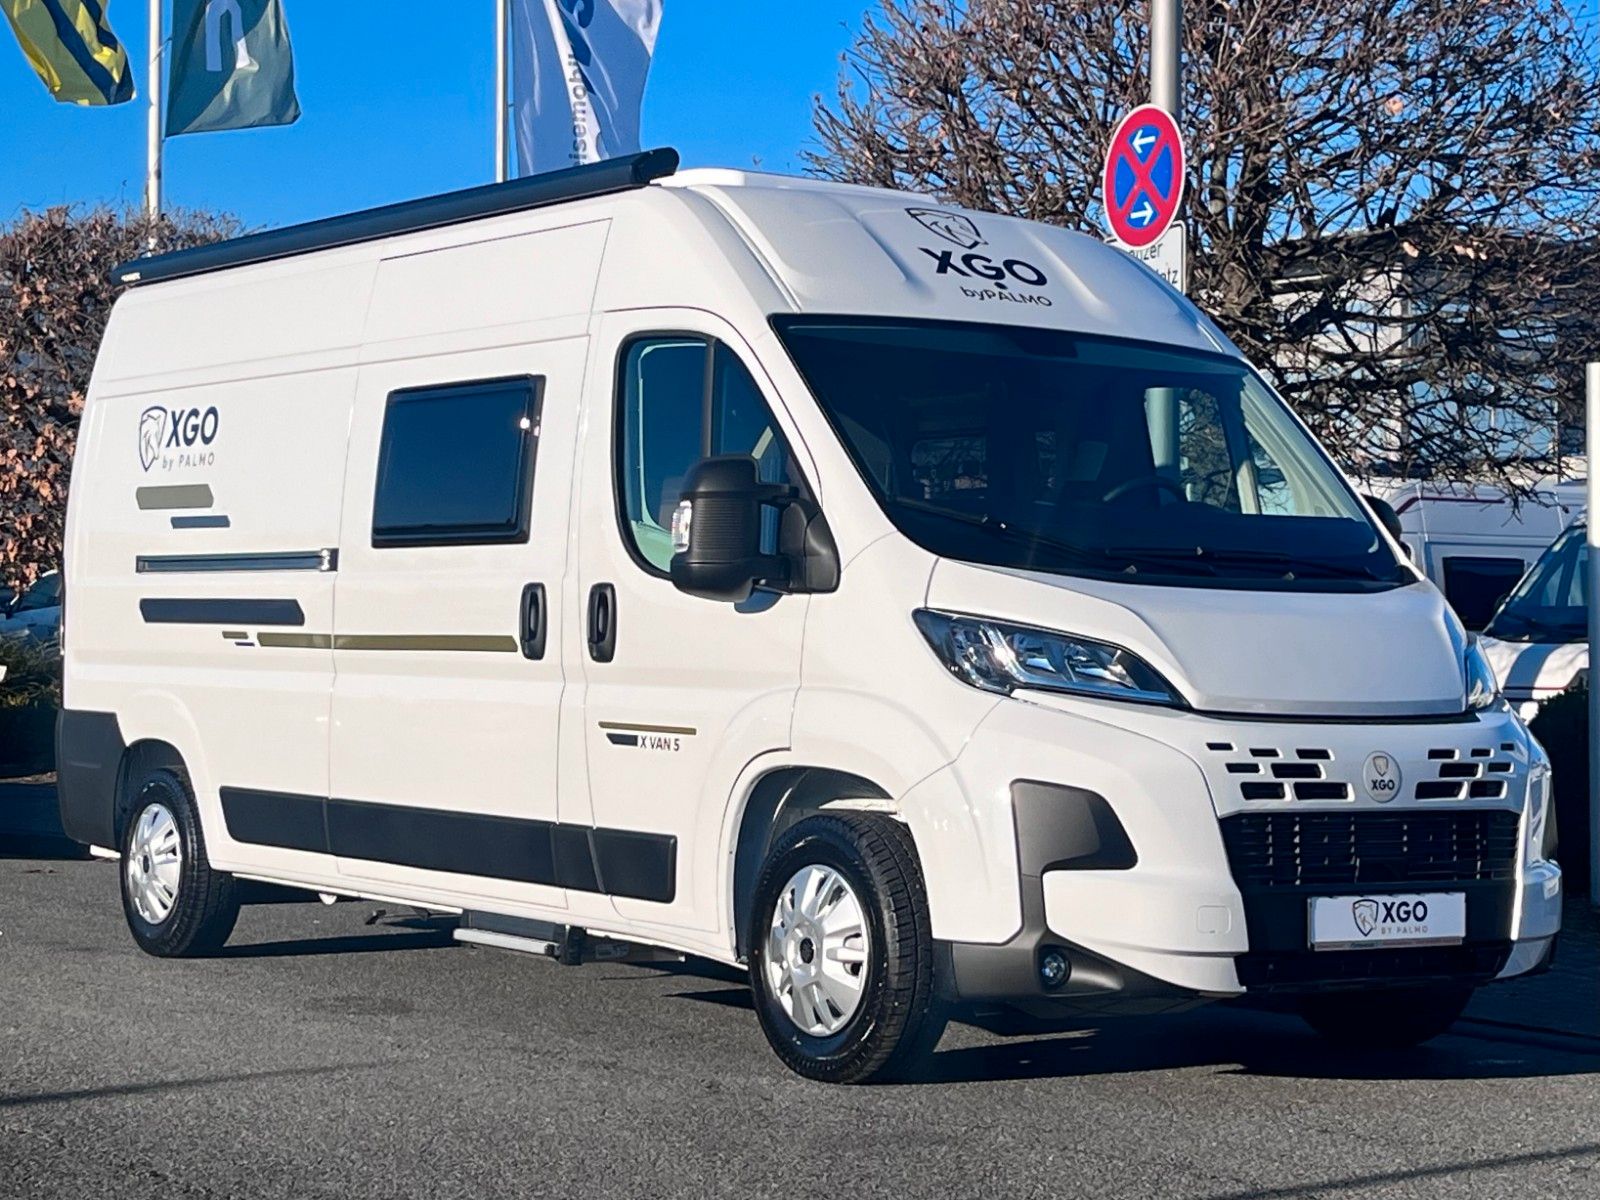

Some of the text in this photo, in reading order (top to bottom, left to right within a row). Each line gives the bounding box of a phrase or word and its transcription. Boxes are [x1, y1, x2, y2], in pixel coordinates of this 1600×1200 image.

[568, 53, 588, 166] isemobi
[917, 247, 1047, 286] XGO
[165, 406, 219, 448] XGO
[162, 452, 215, 471] by PALMO
[640, 736, 647, 748] X
[650, 737, 671, 750] VAN
[1371, 779, 1395, 790] XGO
[1382, 901, 1428, 923] XGO
[1381, 925, 1428, 935] BY PALMO
